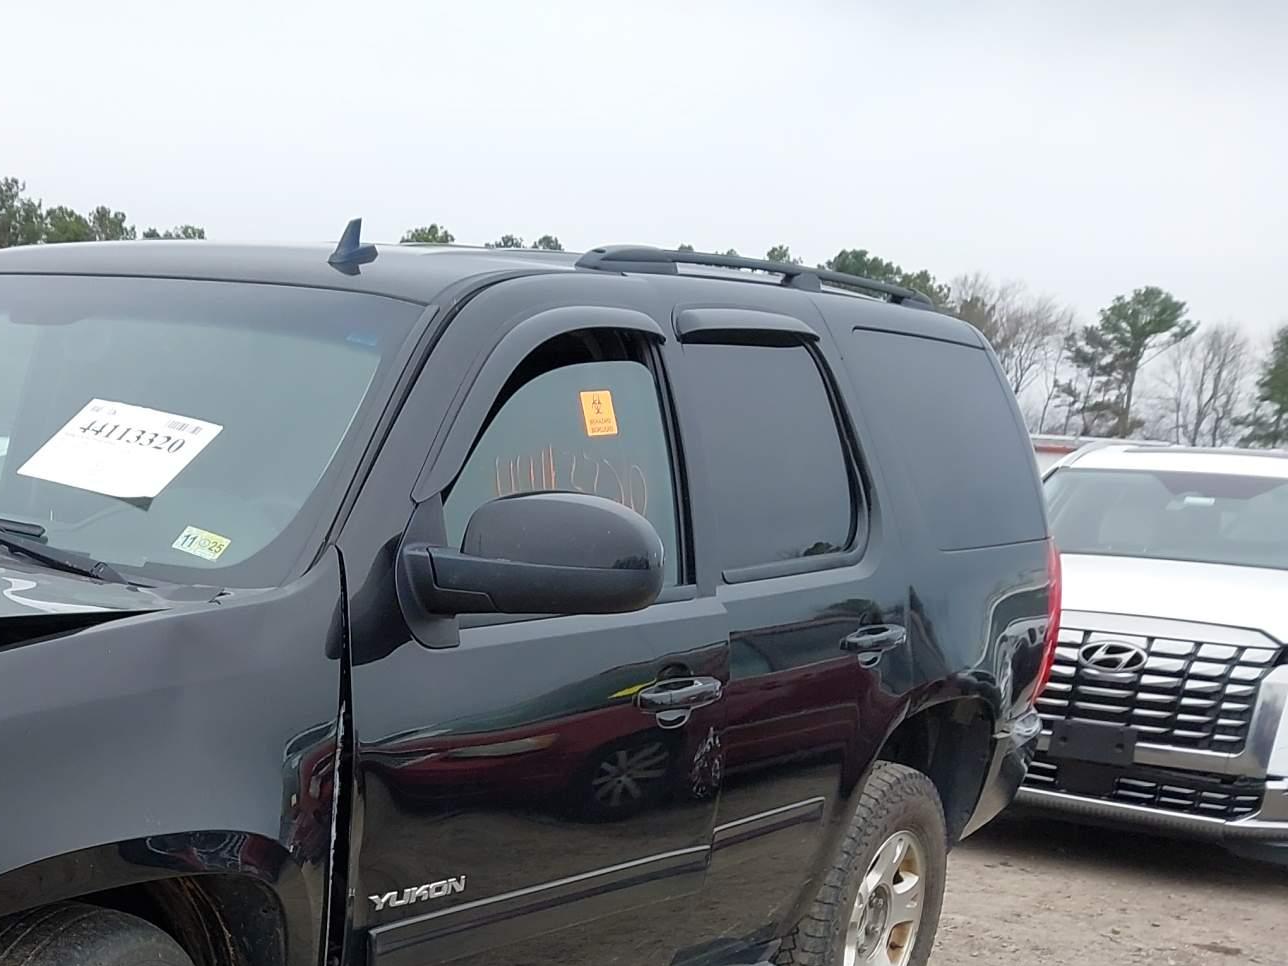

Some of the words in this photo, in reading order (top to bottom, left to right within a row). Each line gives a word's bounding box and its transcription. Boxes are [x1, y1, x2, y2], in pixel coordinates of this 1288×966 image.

[79, 420, 186, 453] 44113320
[181, 534, 199, 548] 11
[208, 541, 225, 553] 25
[368, 875, 466, 911] YUKON
